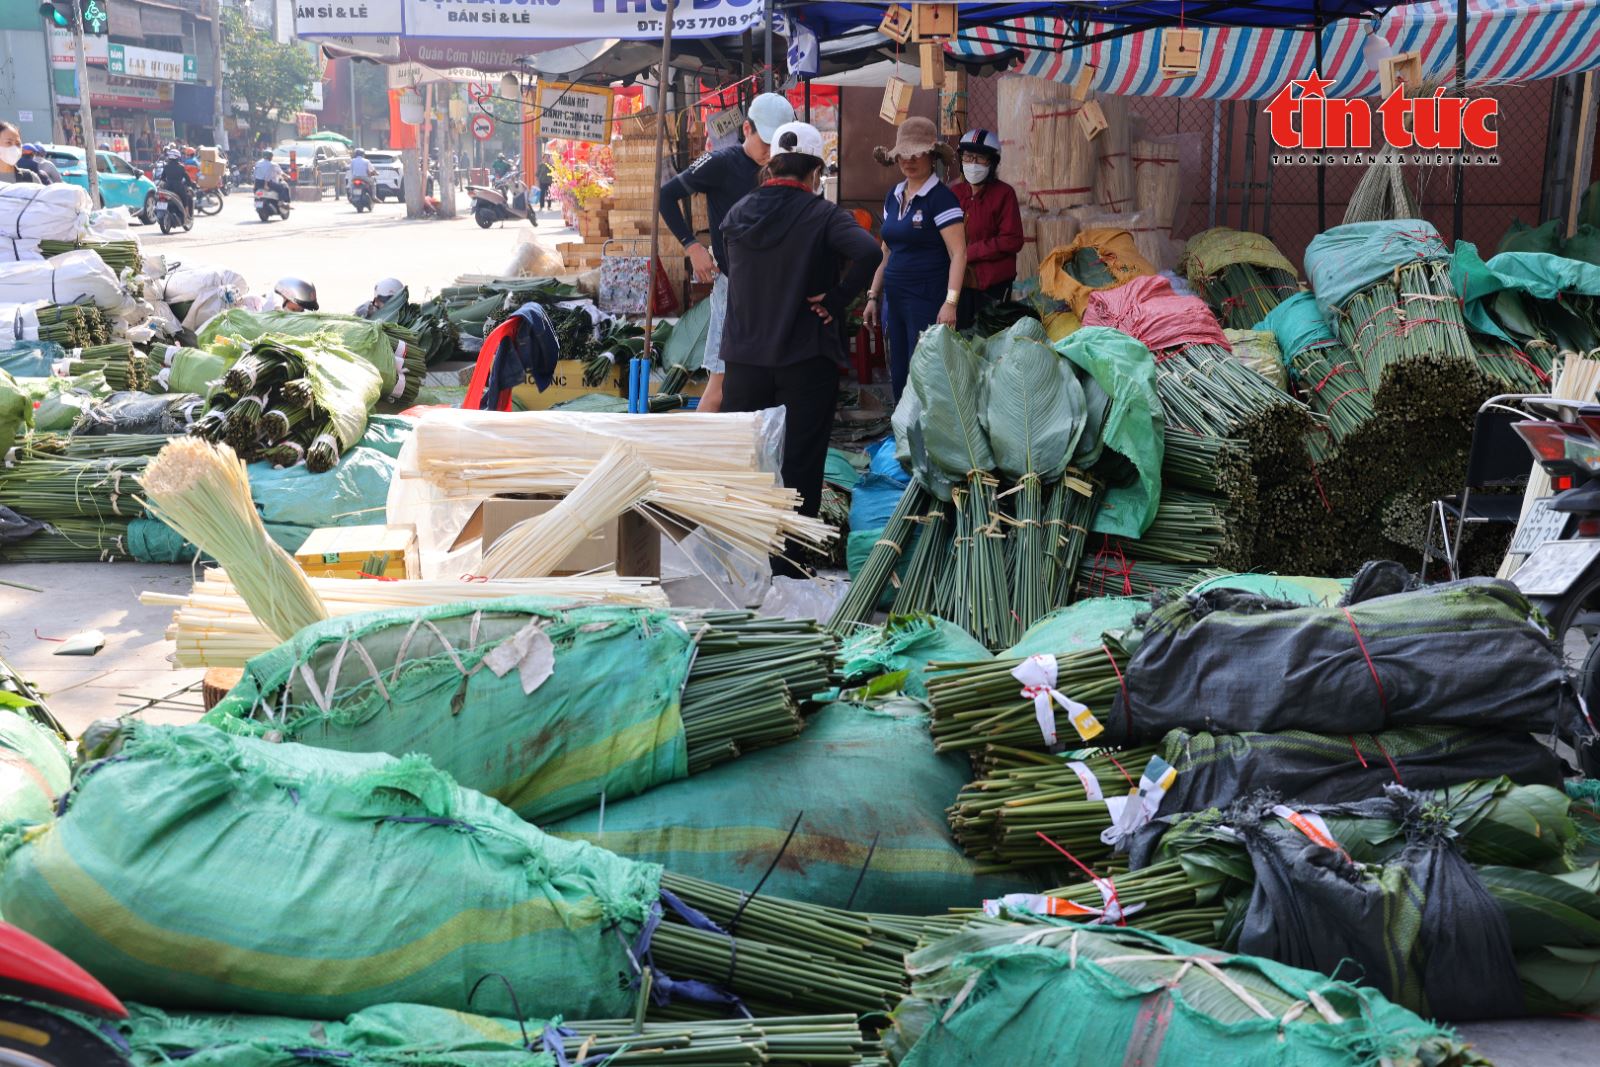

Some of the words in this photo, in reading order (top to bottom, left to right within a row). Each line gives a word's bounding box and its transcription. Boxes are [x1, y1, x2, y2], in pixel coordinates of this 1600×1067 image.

[295, 5, 315, 18] ÁN
[335, 7, 347, 18] &
[447, 8, 478, 23] BÁN
[499, 12, 510, 23] &
[699, 15, 737, 29] 7708
